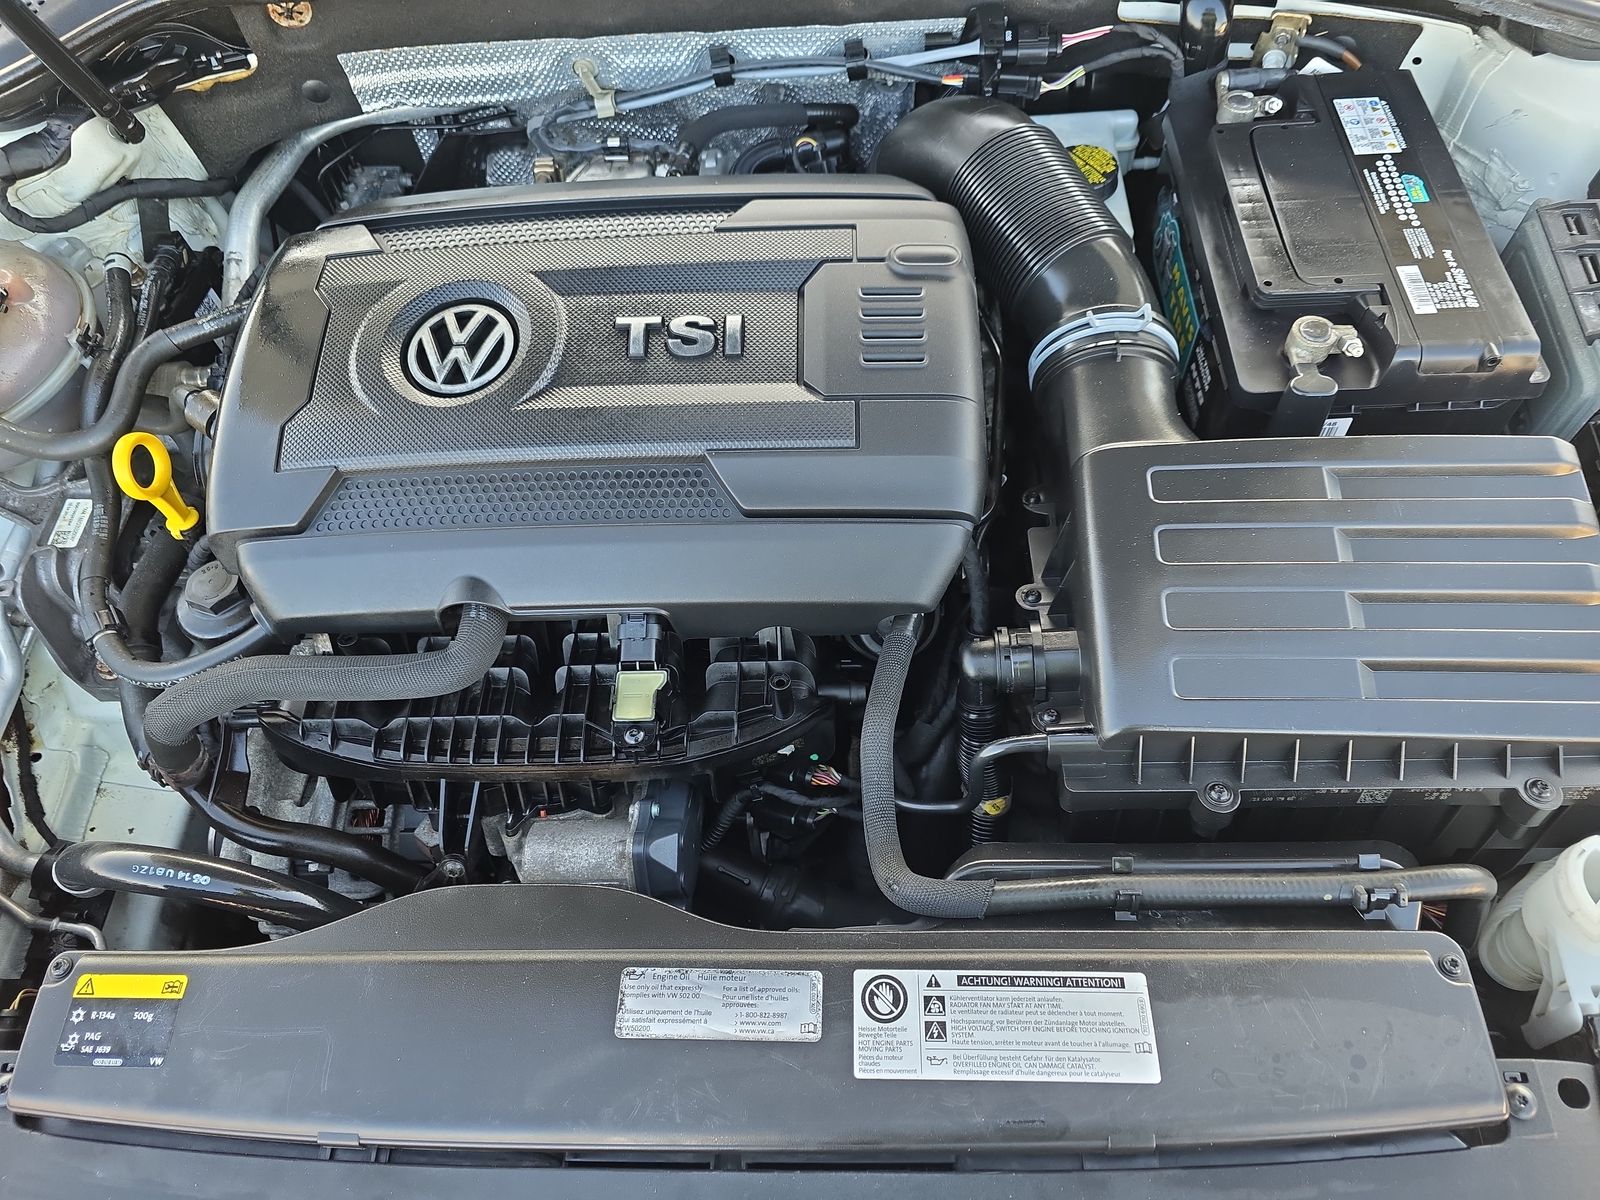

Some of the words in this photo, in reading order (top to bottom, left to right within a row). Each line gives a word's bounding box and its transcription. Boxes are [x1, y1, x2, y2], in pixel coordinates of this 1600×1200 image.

[614, 315, 744, 360] TSI
[652, 972, 678, 982] Engine
[962, 977, 1011, 986] ACHTUNG!
[1014, 977, 1063, 986] WARNING!
[1066, 978, 1121, 987] ATTENTION!
[91, 1012, 115, 1020] R-134a
[133, 1012, 154, 1022] 500g
[84, 1032, 101, 1040] PAG
[150, 1057, 164, 1065] VW
